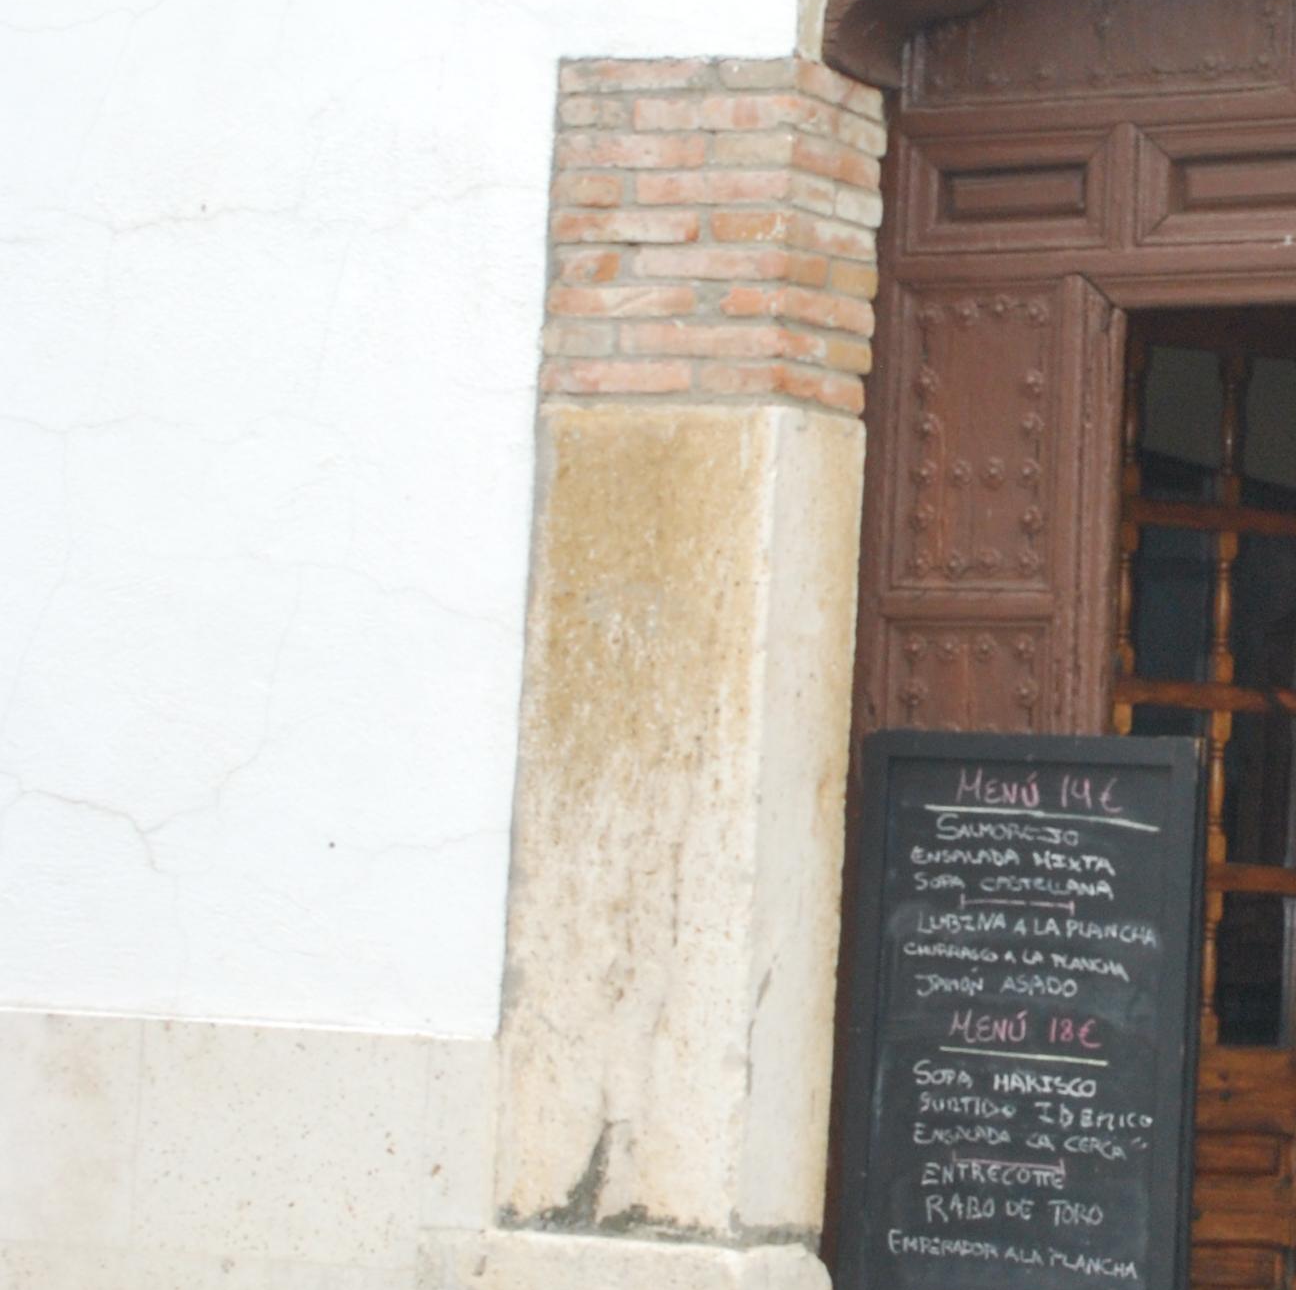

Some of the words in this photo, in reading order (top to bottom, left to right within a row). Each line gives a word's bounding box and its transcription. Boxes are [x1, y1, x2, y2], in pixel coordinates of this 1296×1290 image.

[955, 768, 1041, 807] MENÚ
[935, 812, 1080, 846] SALMOREJO
[910, 845, 1021, 868] ENSALADA
[1032, 850, 1116, 877] MIXTA
[913, 872, 965, 891] SOPA
[980, 876, 1115, 901] CASTELLANA
[917, 912, 1006, 935] LUBINA
[1013, 918, 1027, 935] A
[1033, 917, 1061, 937] LA
[1065, 919, 1158, 948] PLANCHA
[903, 941, 999, 963] CHURRASCO
[1004, 950, 1017, 964] A
[1021, 949, 1044, 965] LA
[1050, 953, 1130, 982] PLANCHA
[914, 966, 985, 997] JAMÓN
[999, 973, 1079, 997] ASADO
[949, 1010, 1029, 1043] MENÚ
[912, 1059, 974, 1089] SOPA
[992, 1071, 1098, 1098] MARISCO
[919, 1091, 1017, 1118] SURTIDO
[912, 1122, 1012, 1146] ENSALADA
[925, 1193, 996, 1223] RABO
[1005, 1198, 1035, 1221] DE
[1047, 1199, 1105, 1227] TORO
[1048, 1246, 1139, 1280] PLANCHA
